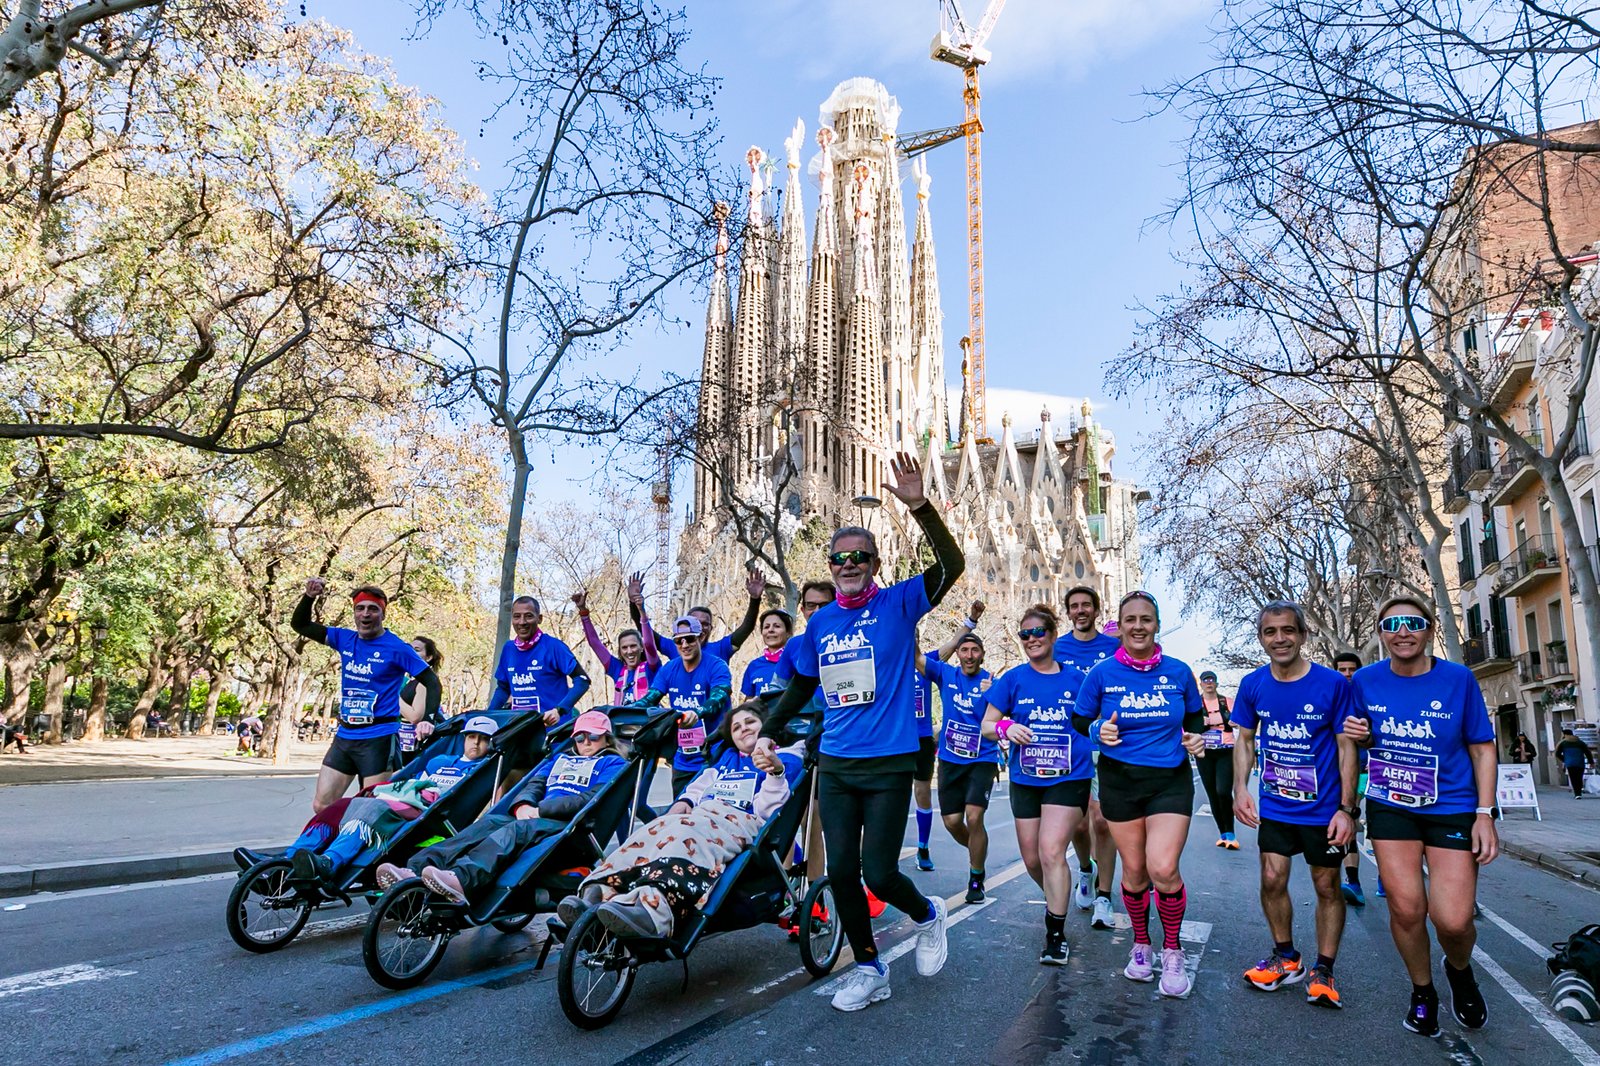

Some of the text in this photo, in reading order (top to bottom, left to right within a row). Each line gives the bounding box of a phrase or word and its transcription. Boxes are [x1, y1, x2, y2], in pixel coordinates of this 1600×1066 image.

[854, 617, 877, 627] ZURICH
[1120, 710, 1170, 719] #imparables
[1420, 710, 1451, 719] ZURICH
[952, 732, 972, 743] AEFAT
[1025, 747, 1065, 758] GONTZAL
[1394, 755, 1419, 763] ZURICH
[1274, 767, 1301, 780] ORIOL
[1382, 767, 1419, 782] AEFAT
[1388, 780, 1412, 791] 26190
